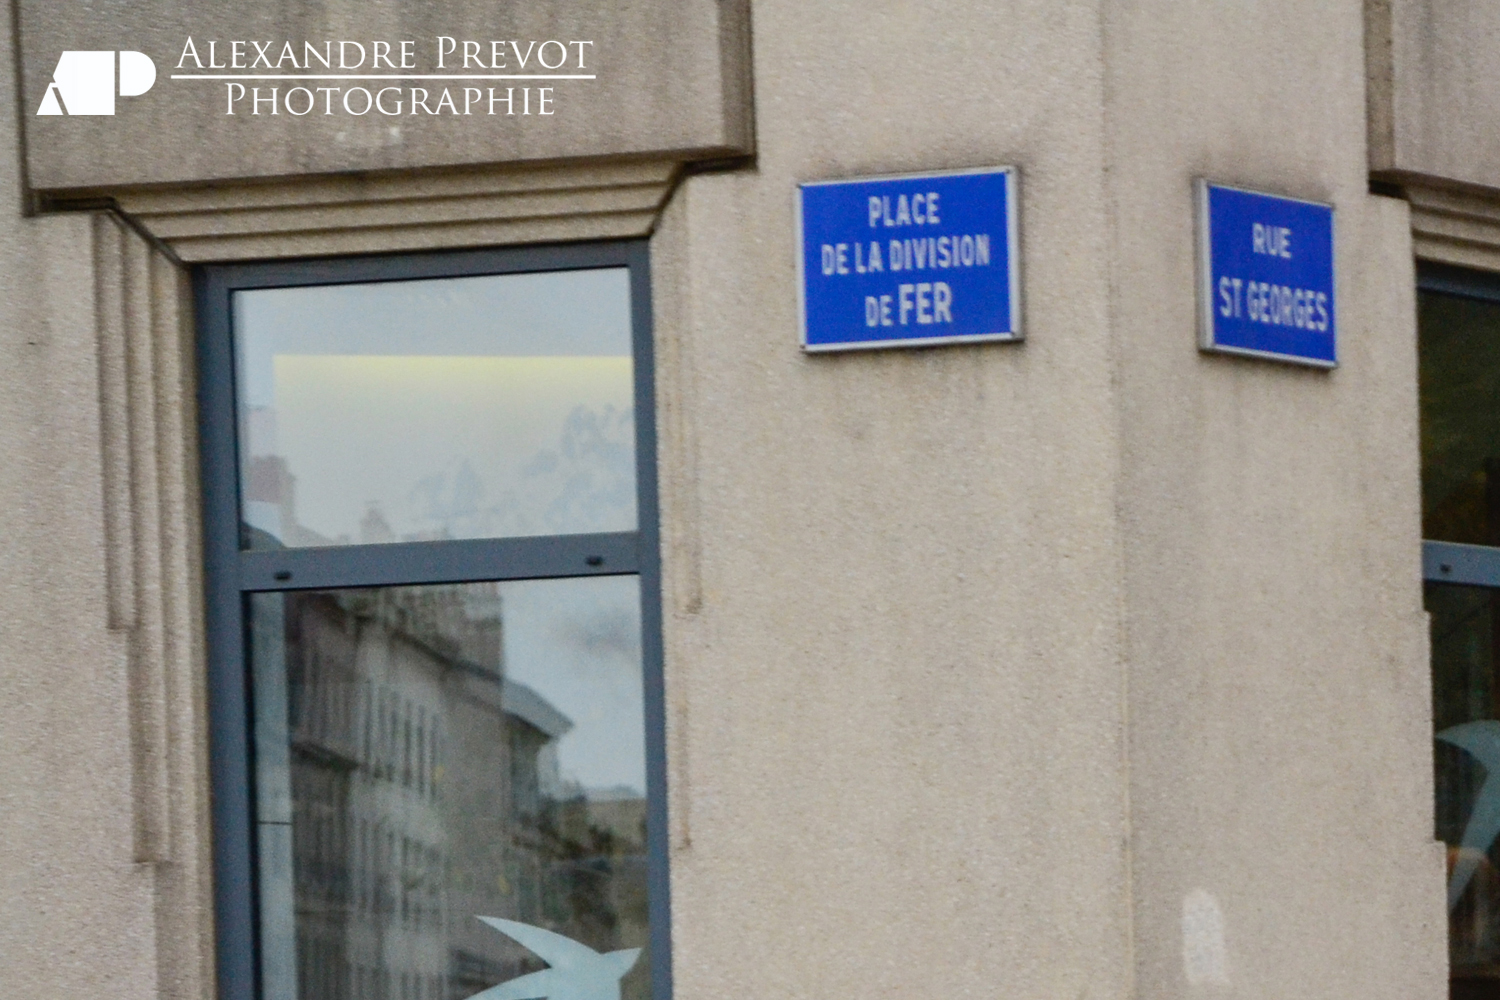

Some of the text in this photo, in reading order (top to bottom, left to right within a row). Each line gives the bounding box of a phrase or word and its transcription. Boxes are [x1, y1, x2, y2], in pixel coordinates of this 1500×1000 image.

[868, 192, 940, 227] PLACE
[821, 234, 991, 276] DE LA DIVISION
[1252, 222, 1292, 259] RUE
[865, 282, 952, 327] DE FER
[1219, 276, 1328, 332] ST GEORGES
